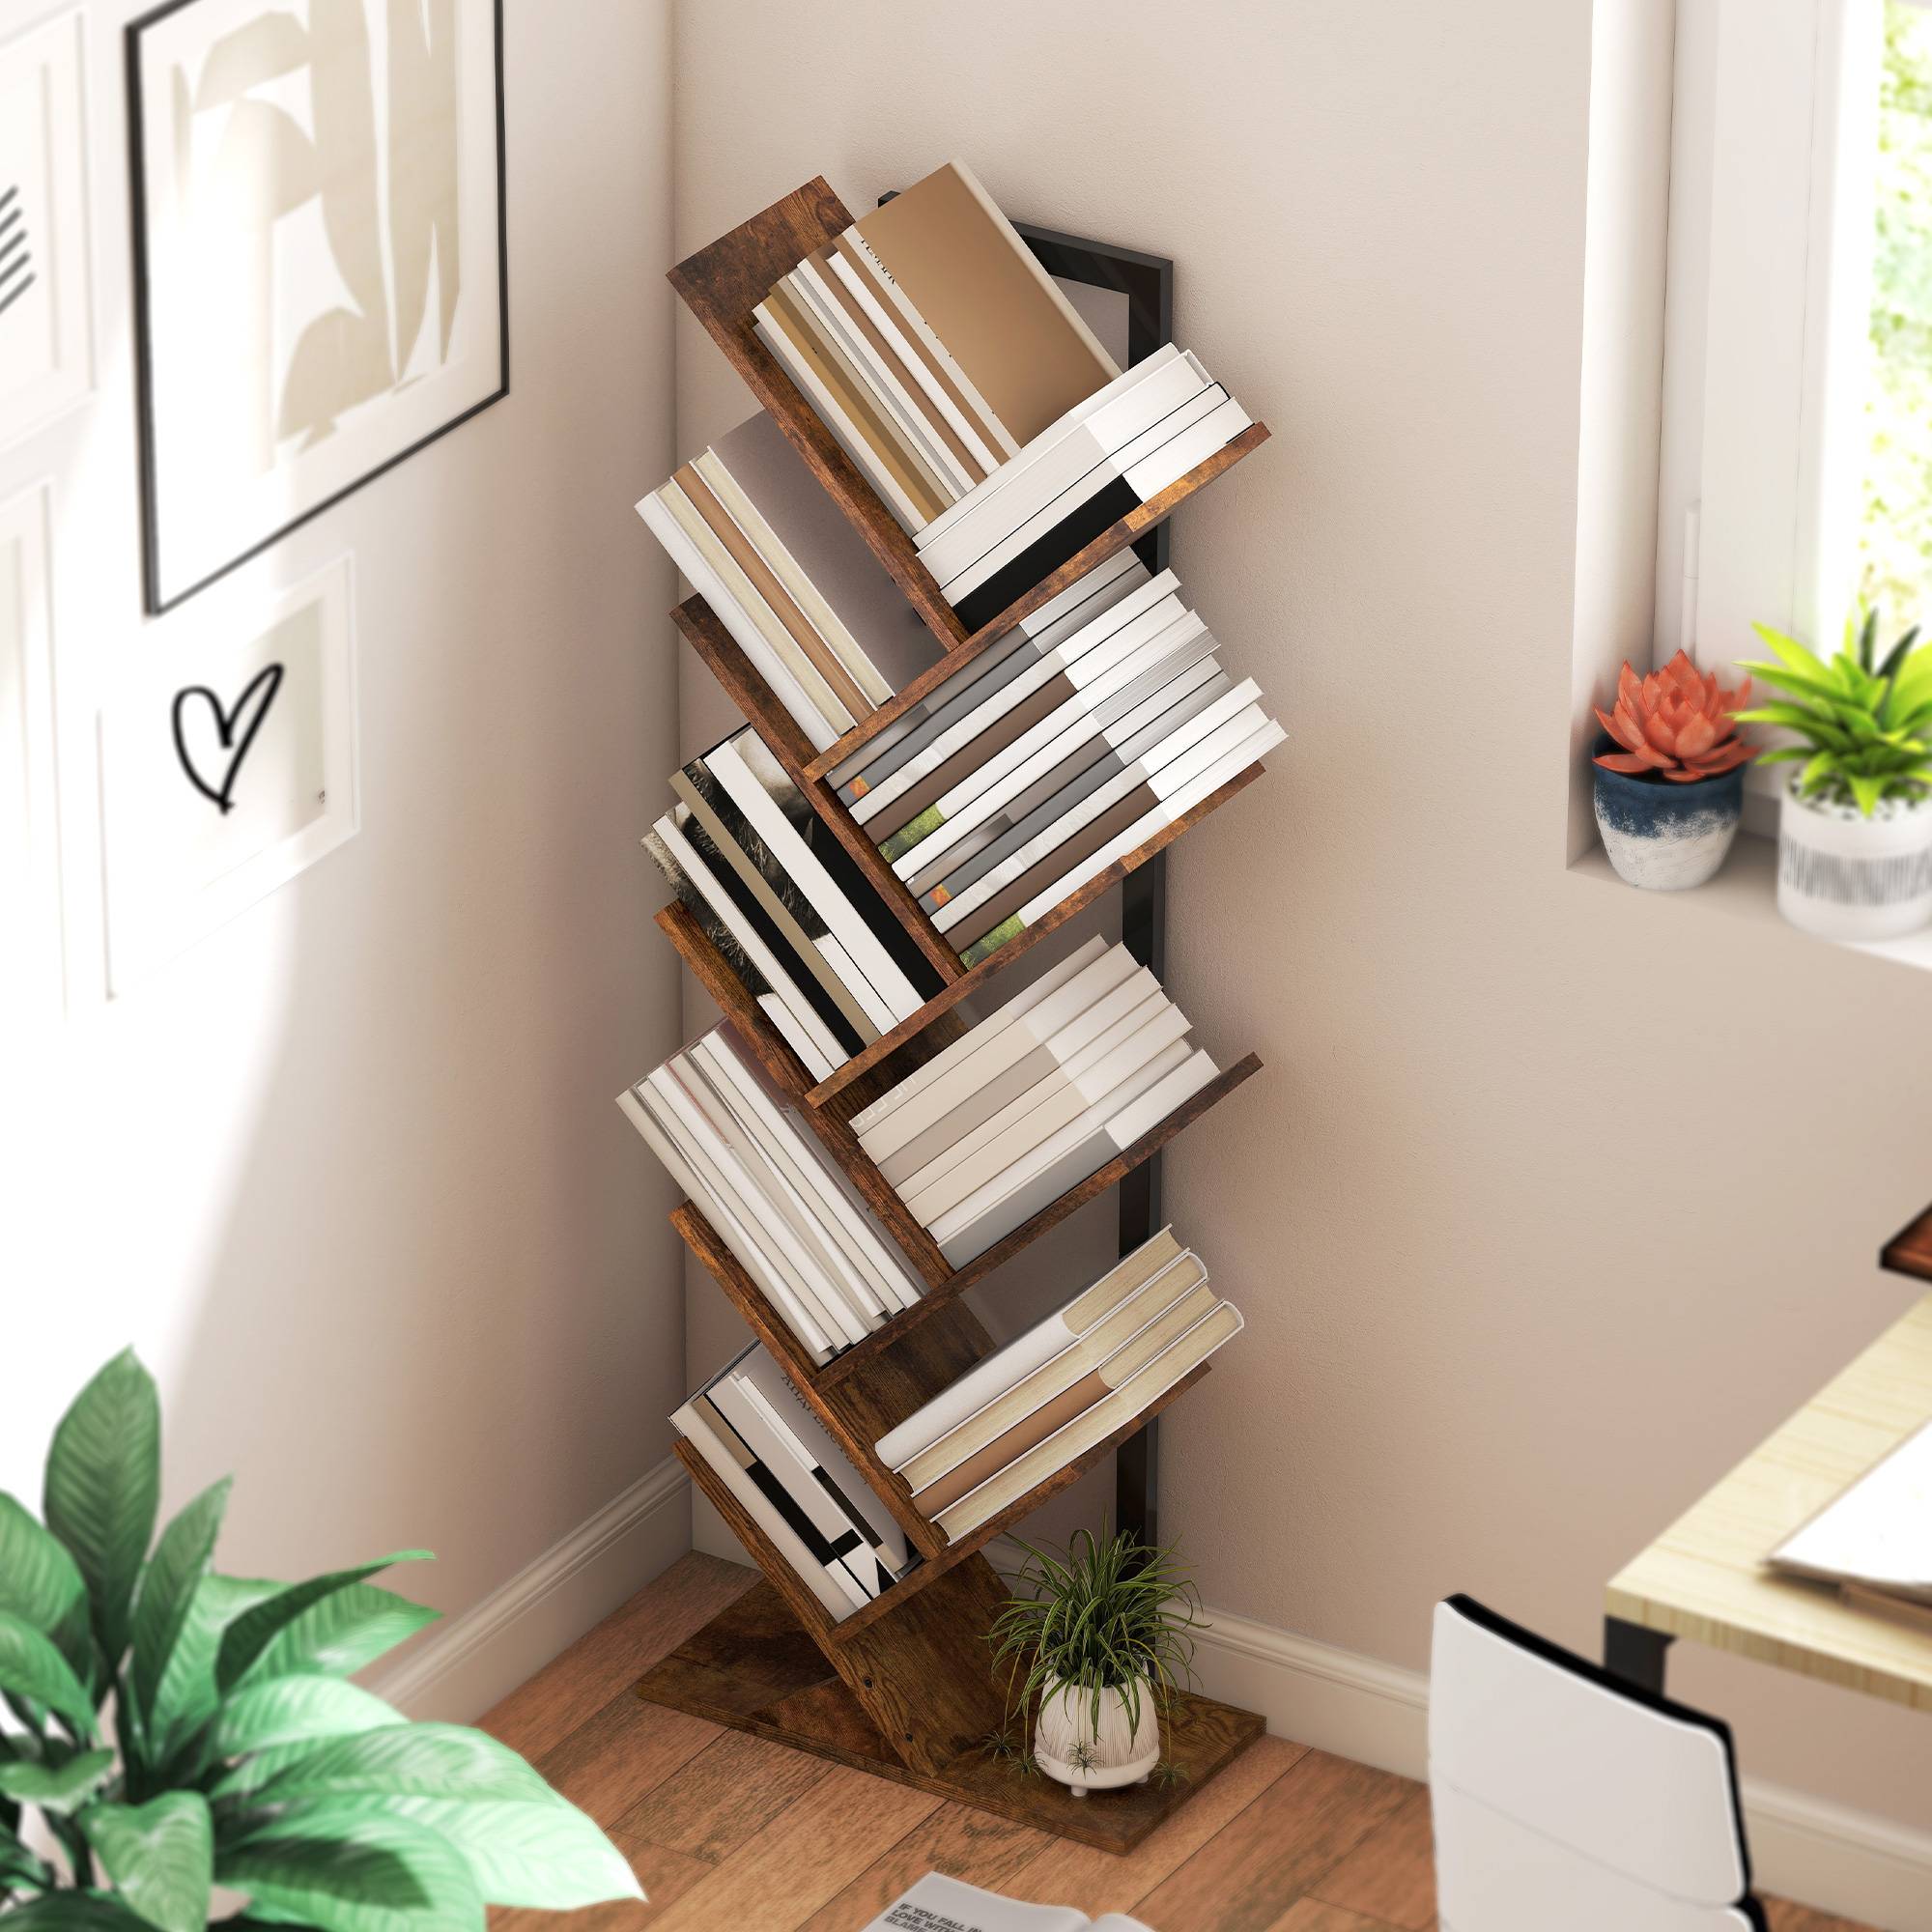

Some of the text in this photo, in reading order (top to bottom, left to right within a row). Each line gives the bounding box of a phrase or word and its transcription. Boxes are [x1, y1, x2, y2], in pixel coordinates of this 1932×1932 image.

[891, 1909, 923, 1924] LOVE
[913, 1908, 938, 1920] YOU
[937, 1917, 965, 1932] FALL
